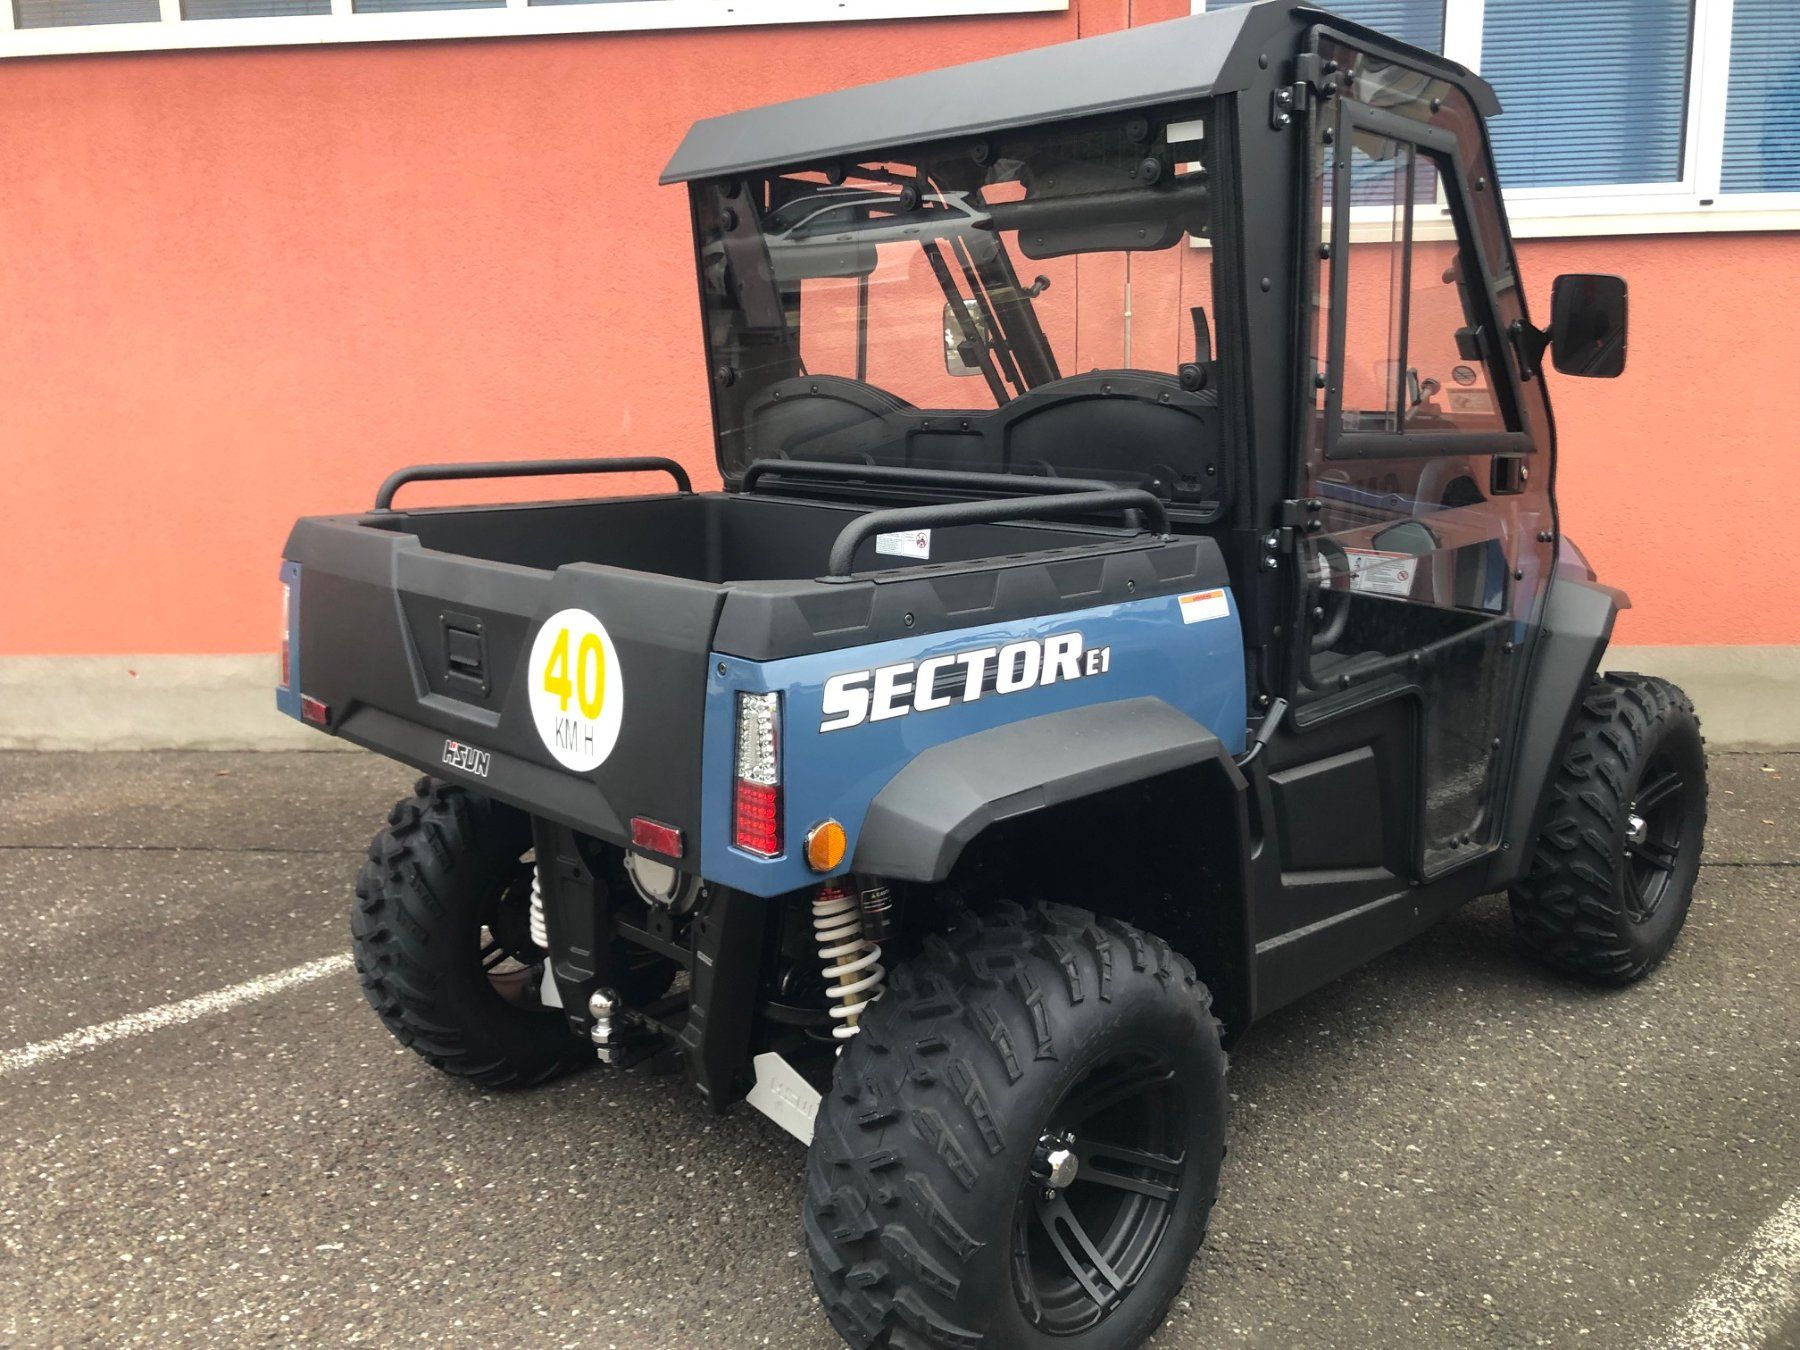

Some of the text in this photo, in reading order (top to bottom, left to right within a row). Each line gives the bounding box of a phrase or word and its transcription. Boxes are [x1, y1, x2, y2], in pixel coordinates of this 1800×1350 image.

[544, 628, 605, 719] 40
[819, 632, 1110, 733] SECTOR E1
[442, 739, 490, 777] HSUN
